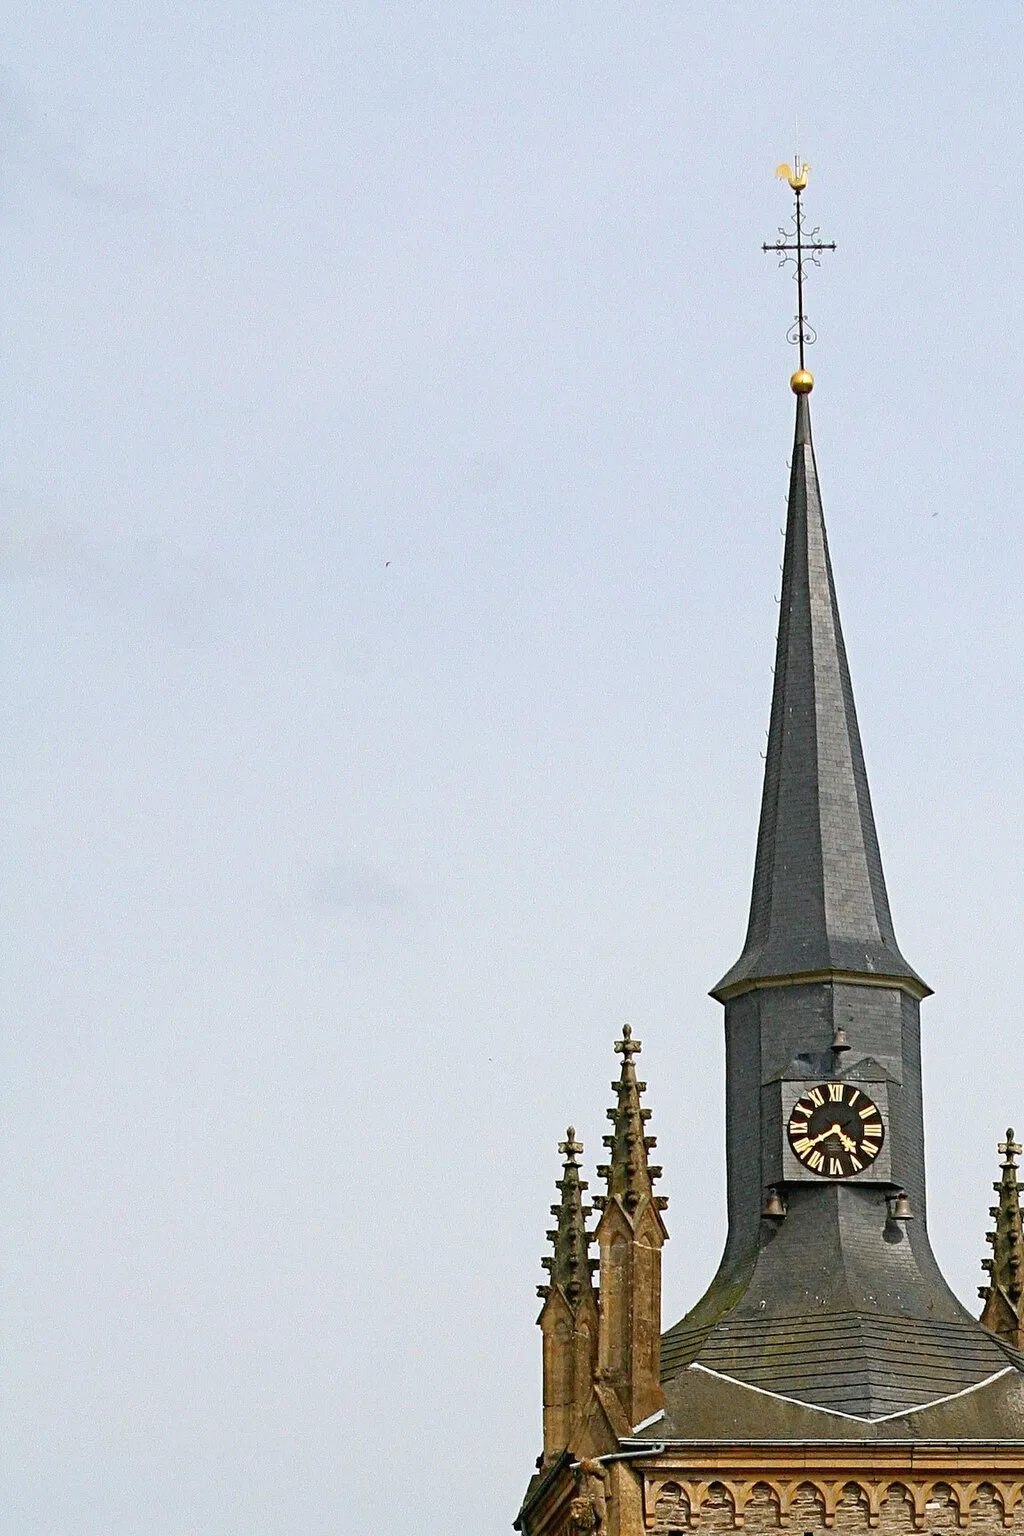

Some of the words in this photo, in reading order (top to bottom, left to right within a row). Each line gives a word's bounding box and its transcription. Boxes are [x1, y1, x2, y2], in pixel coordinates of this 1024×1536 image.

[808, 1087, 825, 1108] XI
[827, 1084, 844, 1102] XII
[848, 1090, 860, 1107] I
[794, 1103, 813, 1118] X
[858, 1104, 877, 1120] II
[789, 1120, 808, 1134] IX
[863, 1123, 882, 1137] III
[860, 1139, 879, 1158] IV
[807, 1150, 825, 1172] VII
[829, 1157, 844, 1175] VI
[850, 1154, 863, 1172] V
